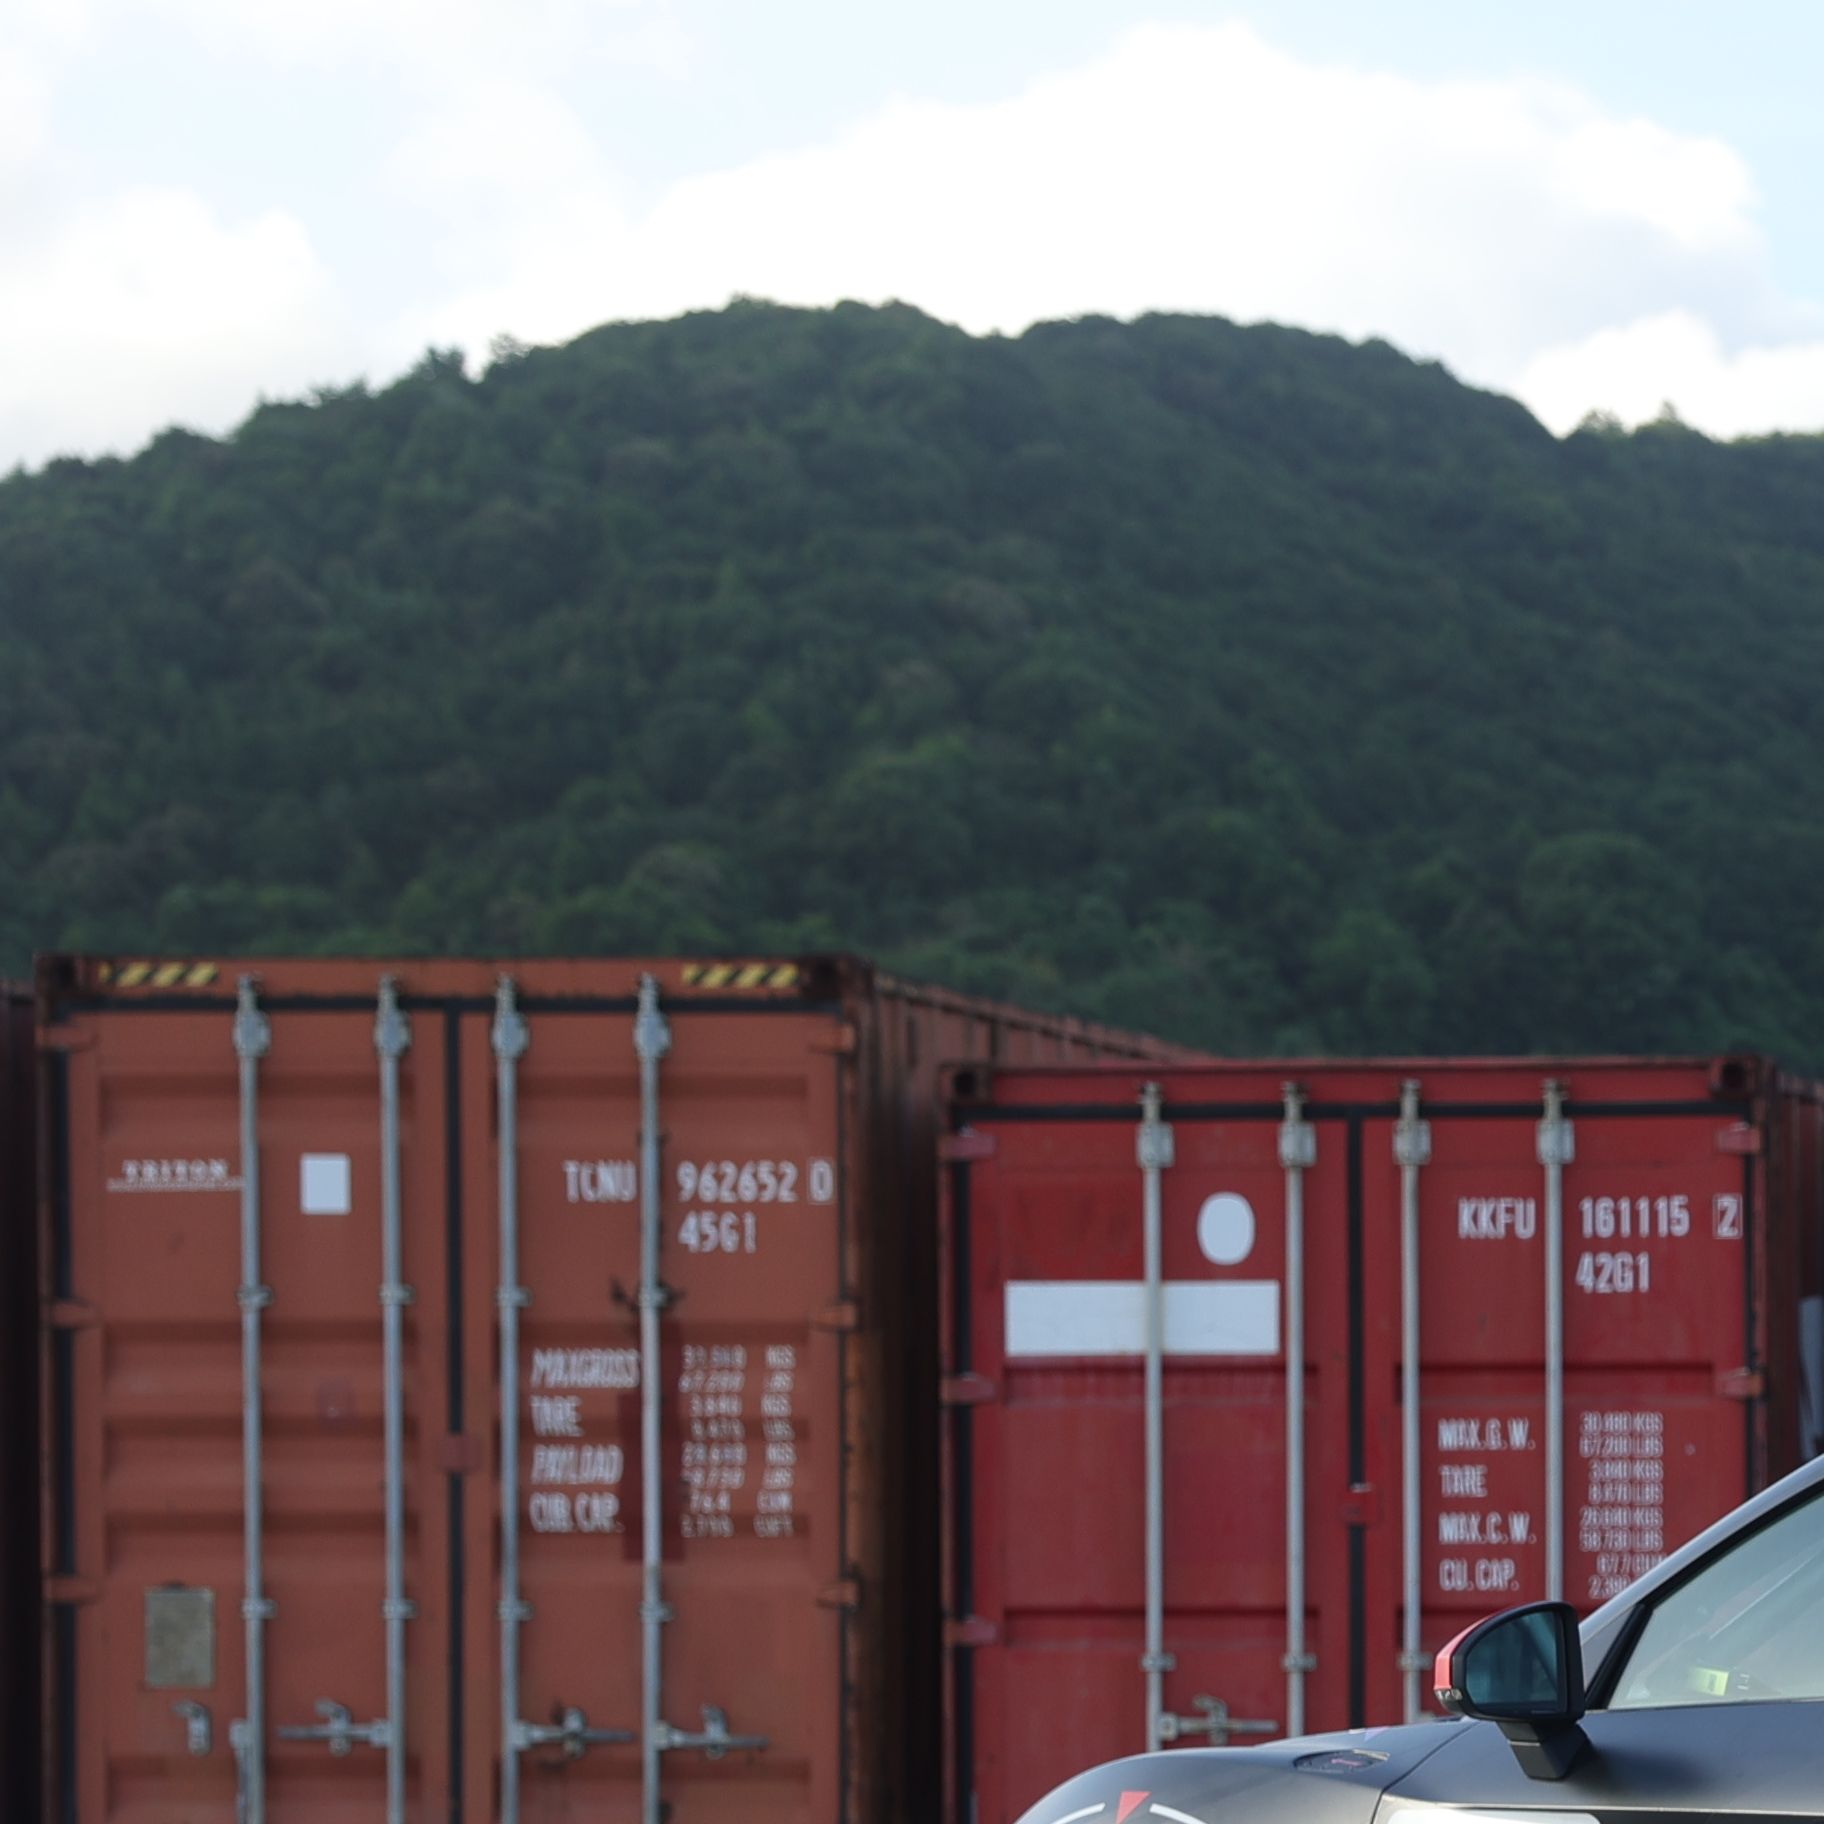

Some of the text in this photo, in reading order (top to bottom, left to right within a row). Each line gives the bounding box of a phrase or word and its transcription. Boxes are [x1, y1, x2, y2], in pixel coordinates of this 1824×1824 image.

[563, 1160, 637, 1203] TCNU
[677, 1160, 798, 1203] 962652
[678, 1211, 757, 1253] 45G1
[1458, 1195, 1739, 1239] KKFU 161115 2
[1575, 1252, 1650, 1293] 42G1
[531, 1445, 624, 1485] PAYLOAD
[1439, 1464, 1488, 1497] TARE
